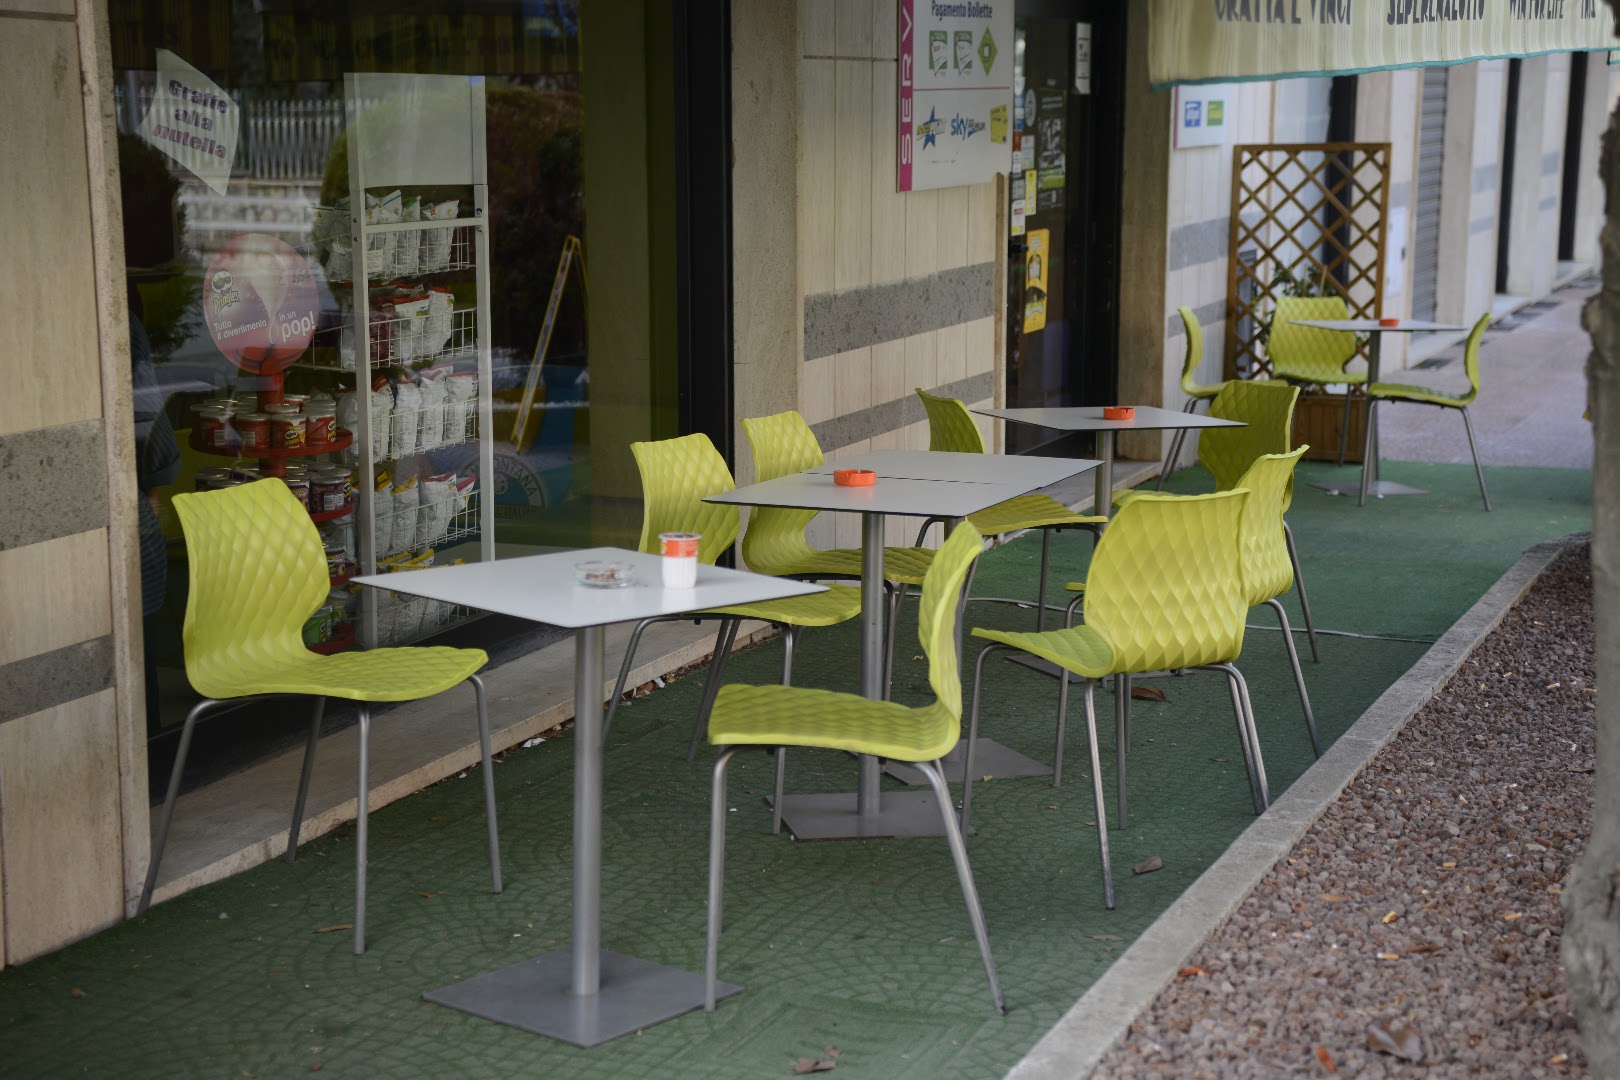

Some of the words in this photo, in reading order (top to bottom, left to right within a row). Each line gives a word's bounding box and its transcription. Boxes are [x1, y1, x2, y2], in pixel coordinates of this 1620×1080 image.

[931, 0, 967, 21] Pagamento
[968, 1, 993, 19] Bollette
[168, 79, 228, 114] Graffe
[175, 107, 213, 132] alla
[153, 123, 227, 159] nutella
[213, 289, 240, 318] Pringles
[287, 310, 297, 320] un
[212, 320, 233, 334] Tutto
[223, 319, 267, 339] divertimento
[281, 310, 317, 343] pop!
